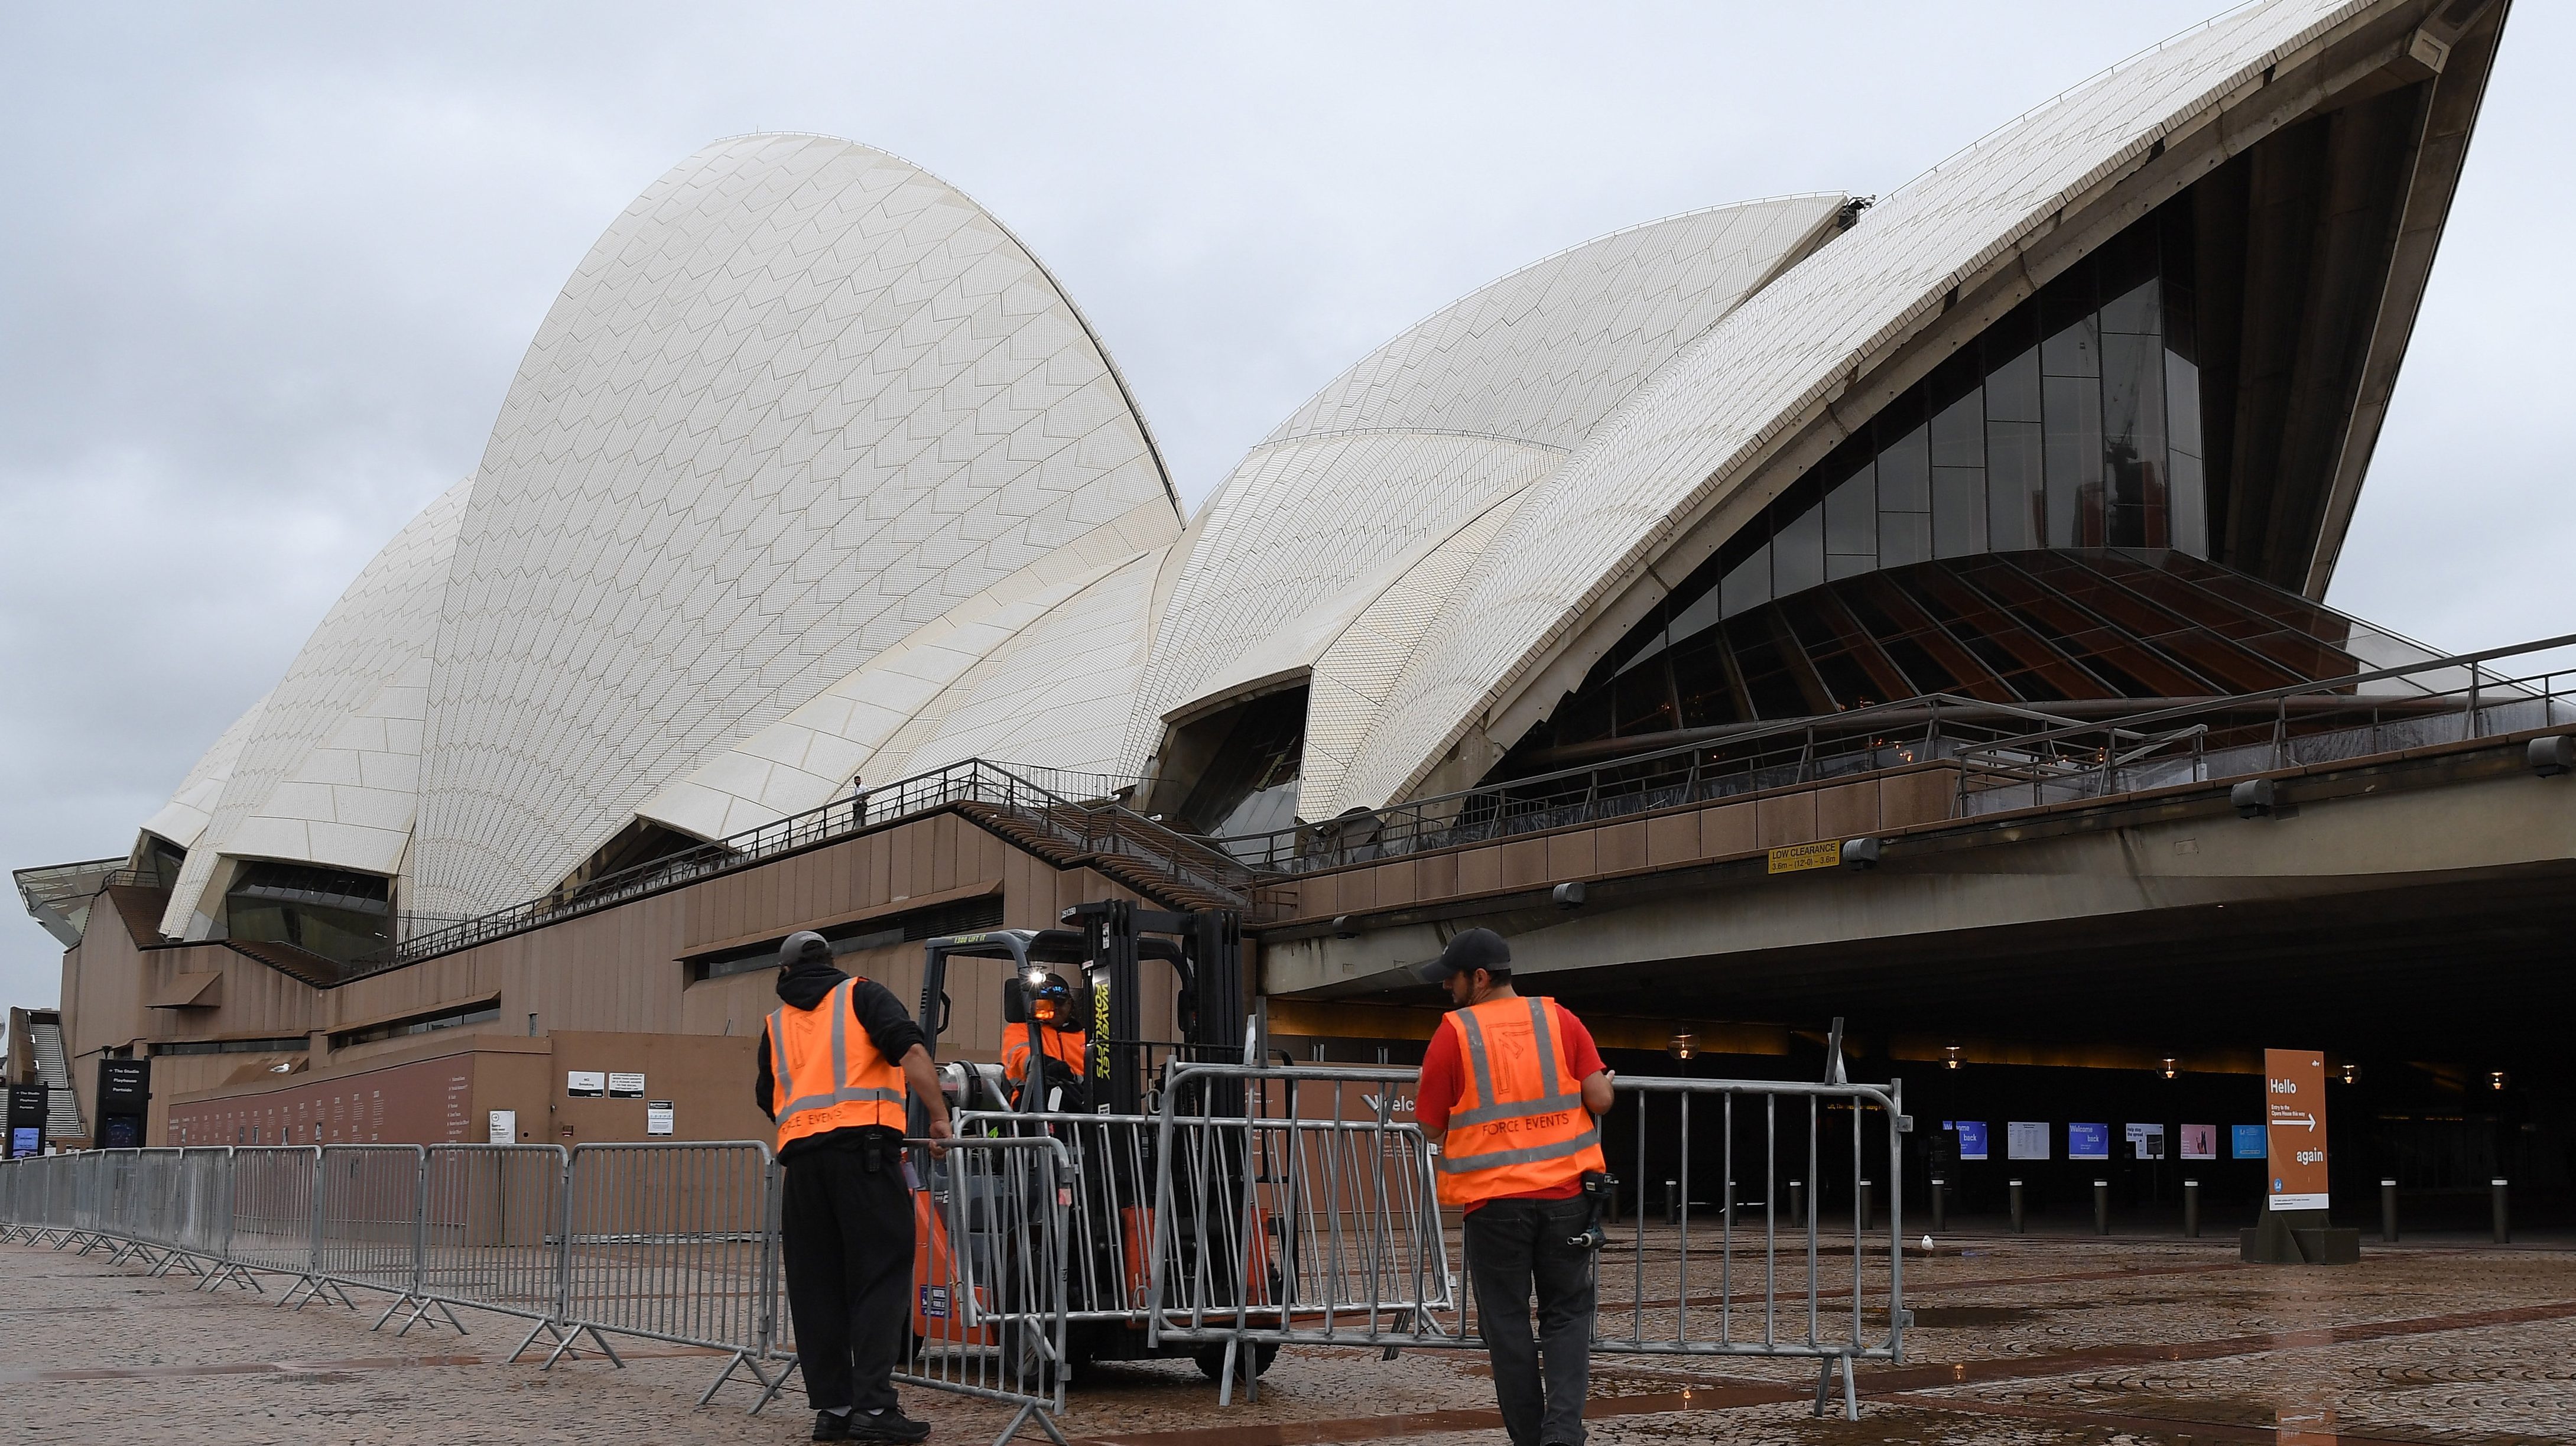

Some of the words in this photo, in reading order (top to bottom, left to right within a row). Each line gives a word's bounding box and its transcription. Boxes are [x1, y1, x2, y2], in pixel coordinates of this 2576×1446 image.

[1773, 850, 1788, 859] LOW
[1791, 843, 1836, 857] CLEARANCE
[1095, 983, 1103, 1079] FORKLFTS
[2270, 1078, 2296, 1093] Hello
[808, 1108, 842, 1125] EVENS
[1483, 1120, 1519, 1136] FORCE
[1526, 1113, 1569, 1130] EVENTS
[2296, 1146, 2323, 1165] again
